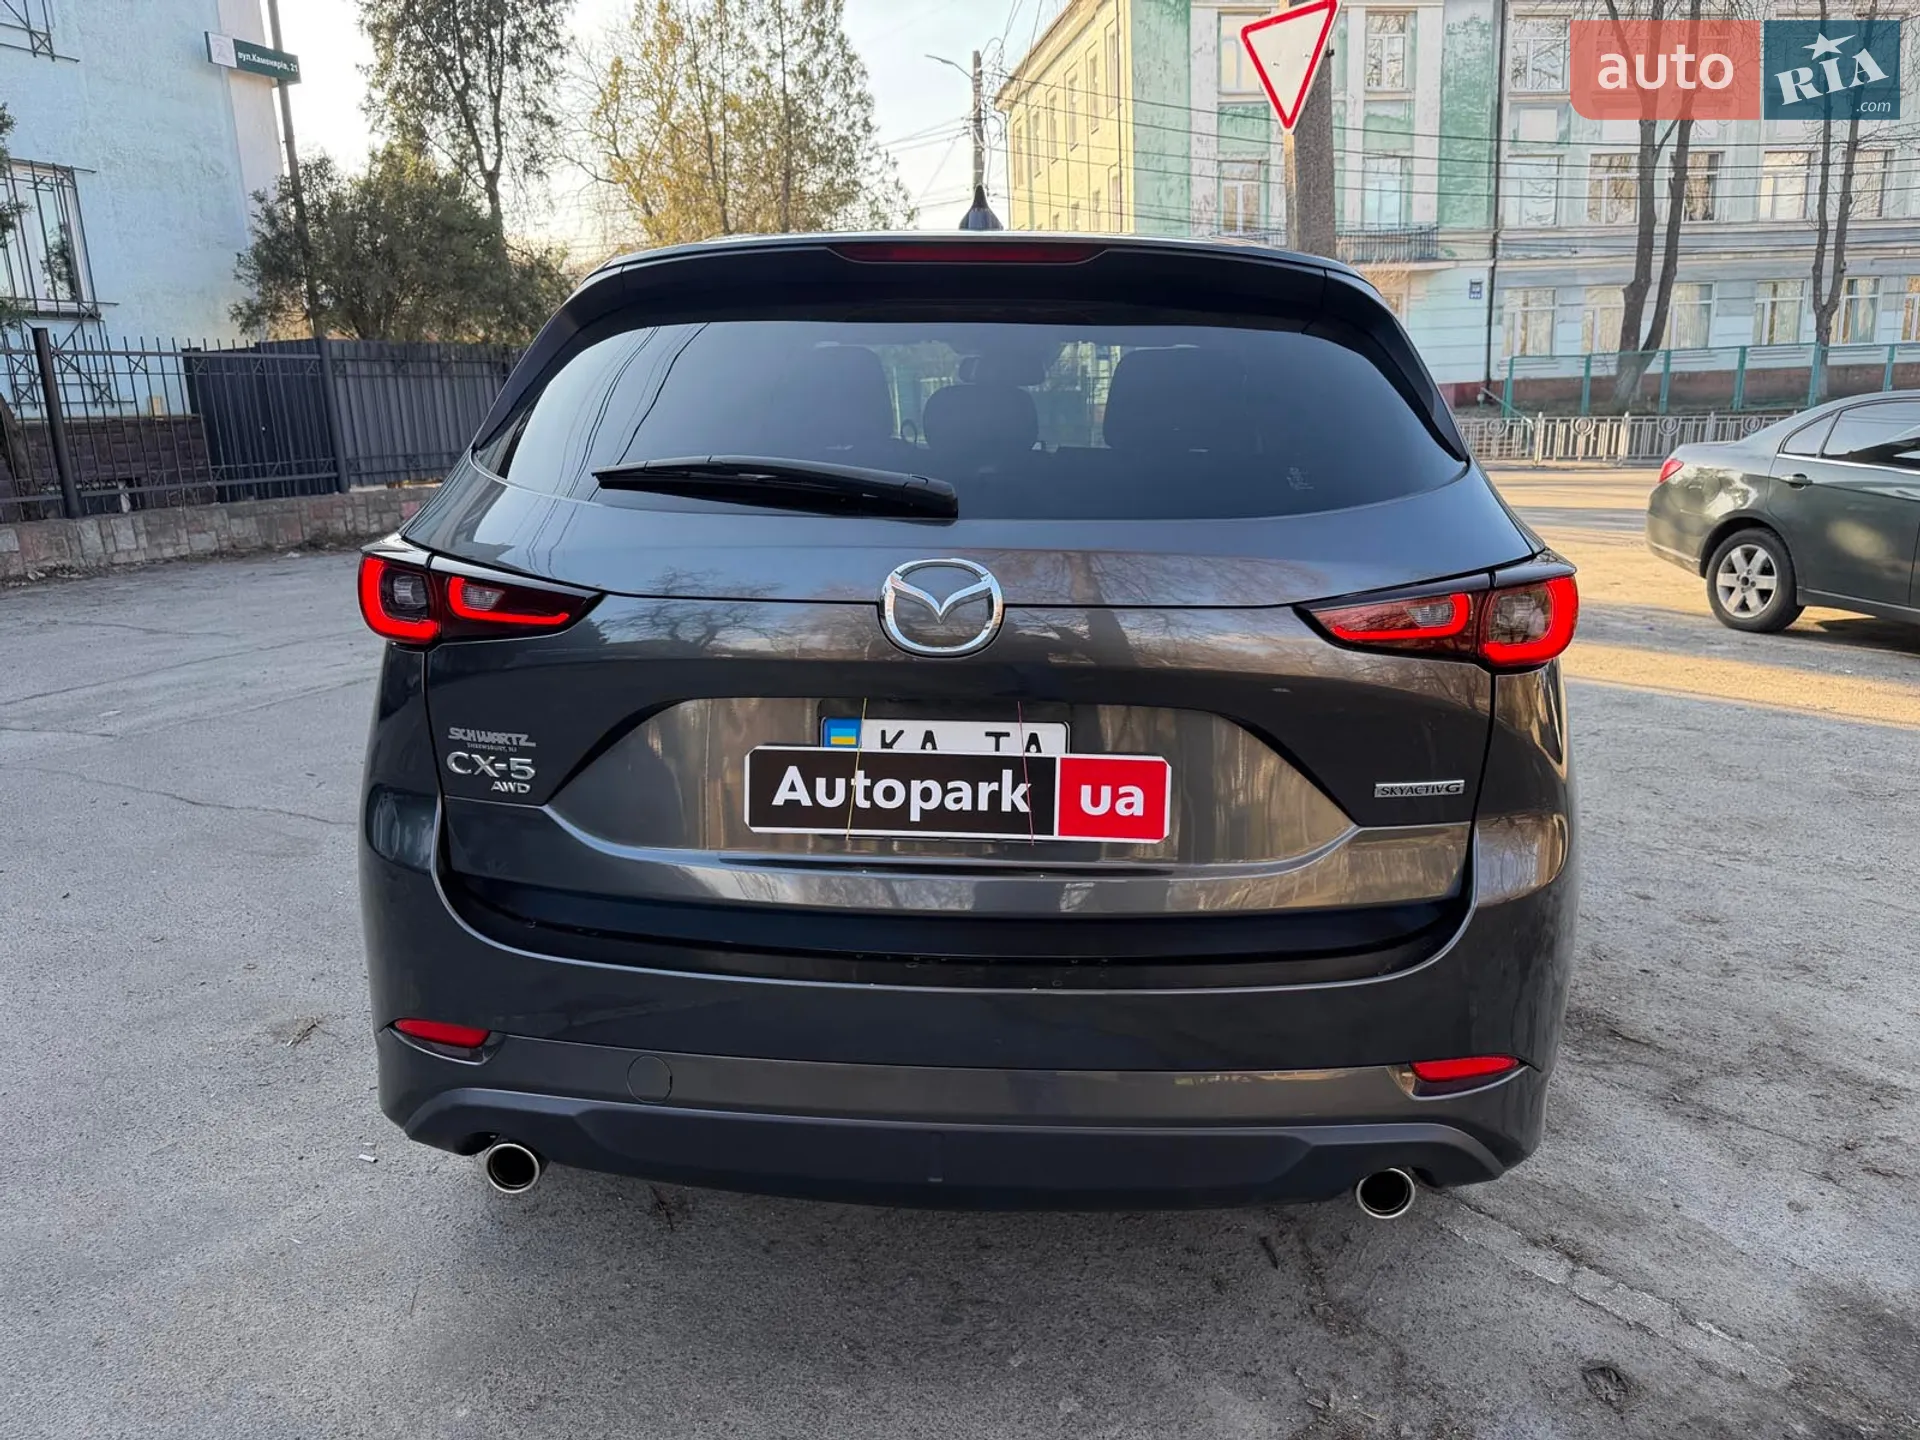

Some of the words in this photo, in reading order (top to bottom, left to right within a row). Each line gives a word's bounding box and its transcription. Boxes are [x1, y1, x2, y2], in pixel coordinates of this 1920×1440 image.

[447, 726, 537, 748] SCHWARTZ
[446, 751, 536, 780] CX-5
[490, 780, 531, 794] AWD
[771, 765, 1032, 823] Autopark
[1079, 783, 1145, 817] ua
